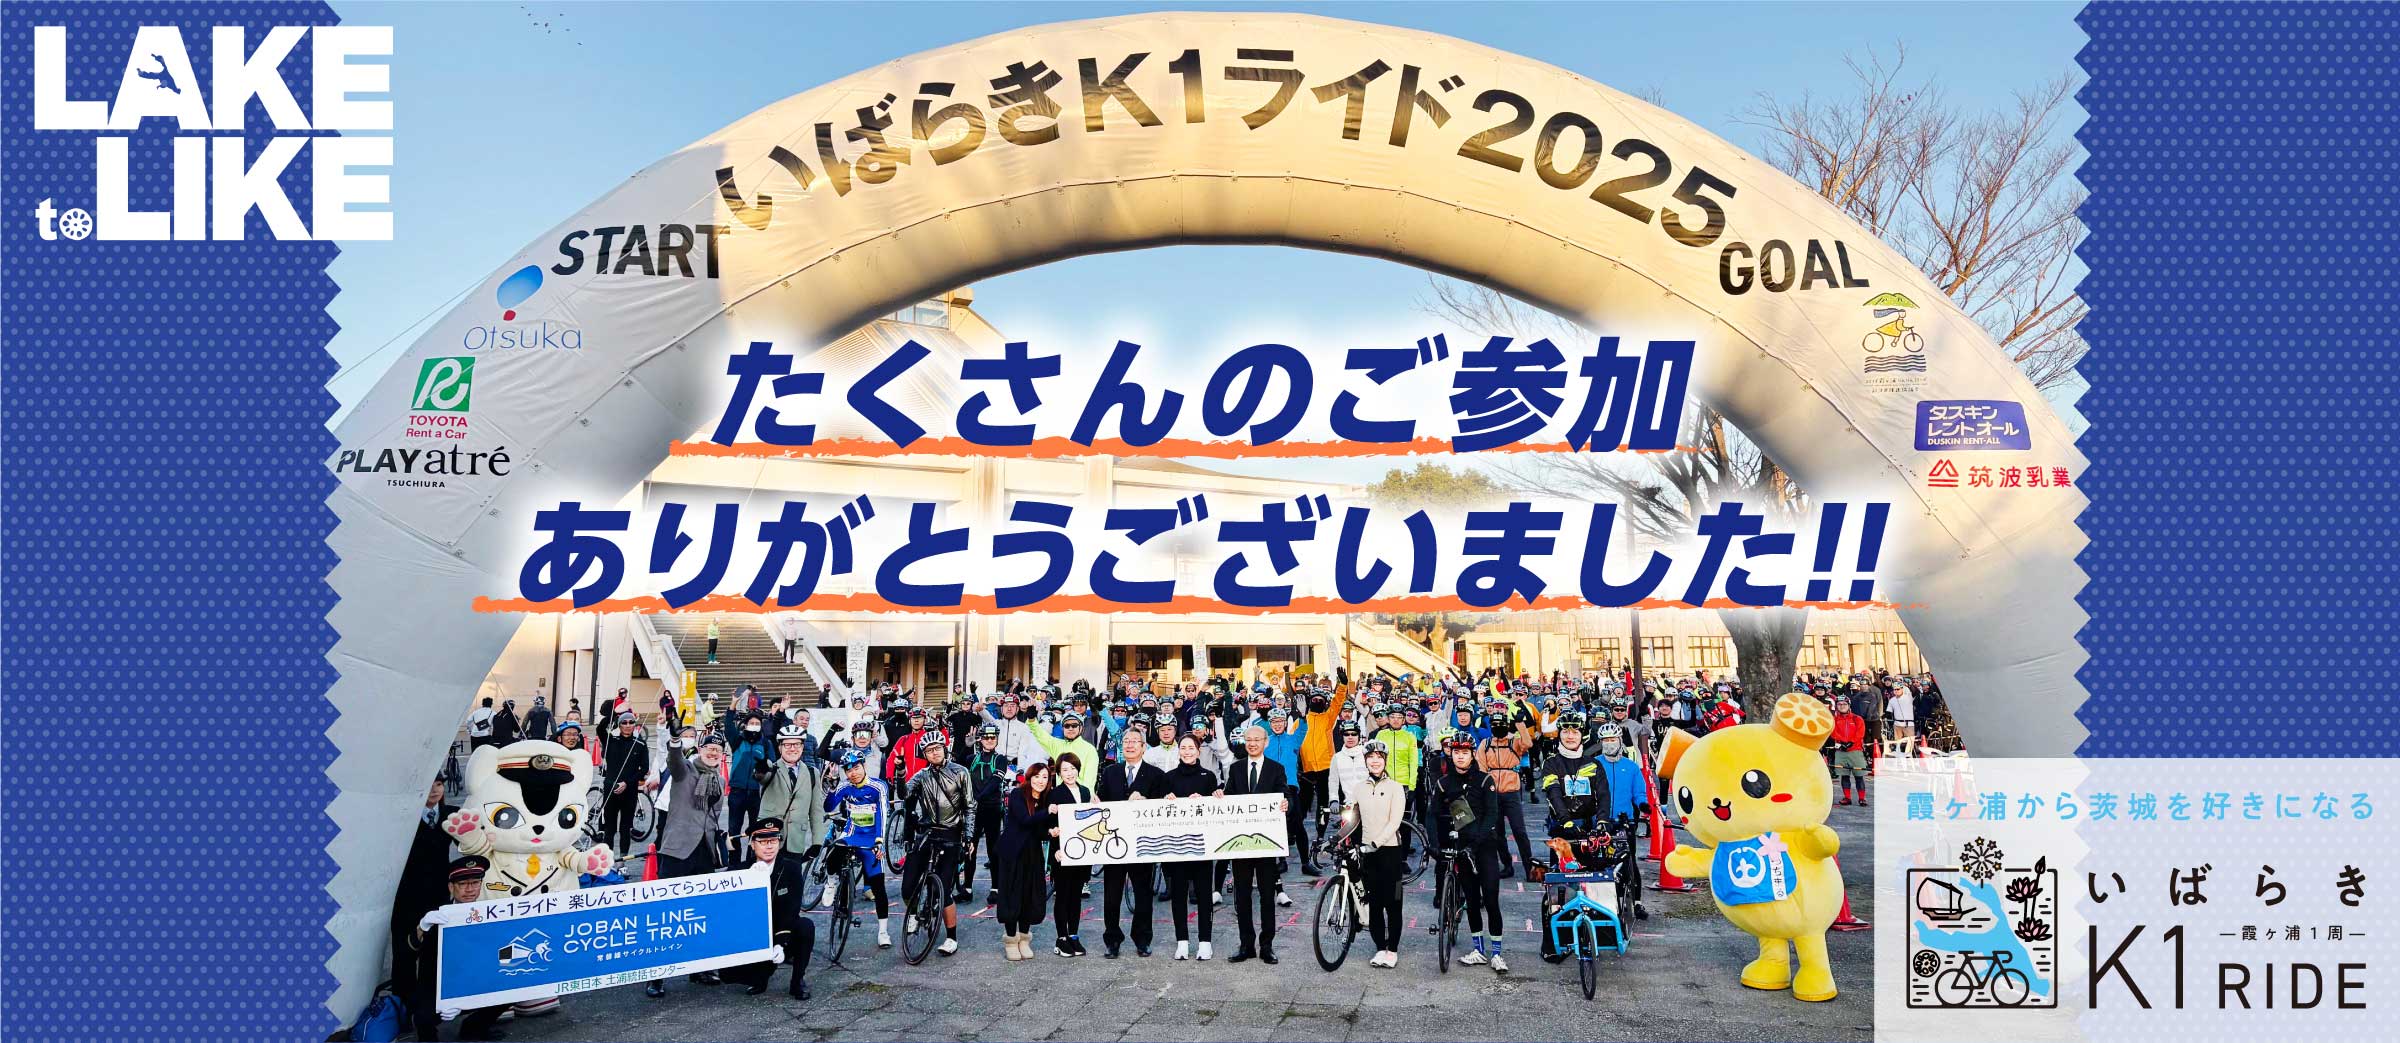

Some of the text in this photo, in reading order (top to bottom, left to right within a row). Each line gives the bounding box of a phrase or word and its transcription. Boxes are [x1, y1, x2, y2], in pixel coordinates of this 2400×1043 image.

[714, 48, 1737, 248] いばらきK1ライド2025
[551, 223, 730, 279] START
[1719, 239, 1869, 296] GOAL
[464, 322, 582, 350] Otsuka
[409, 415, 468, 427] TOYOTA
[406, 428, 468, 439] Rent a Car
[1927, 437, 1961, 446] DUSKIN
[387, 479, 446, 488] TSUCHIURA
[1968, 465, 2073, 489] 筑波乳業
[486, 897, 558, 920] K-1ライド
[564, 908, 706, 938] JOBAN LINE
[563, 921, 707, 954] CYCLE TRAIN
[554, 977, 602, 994] JR東日本
